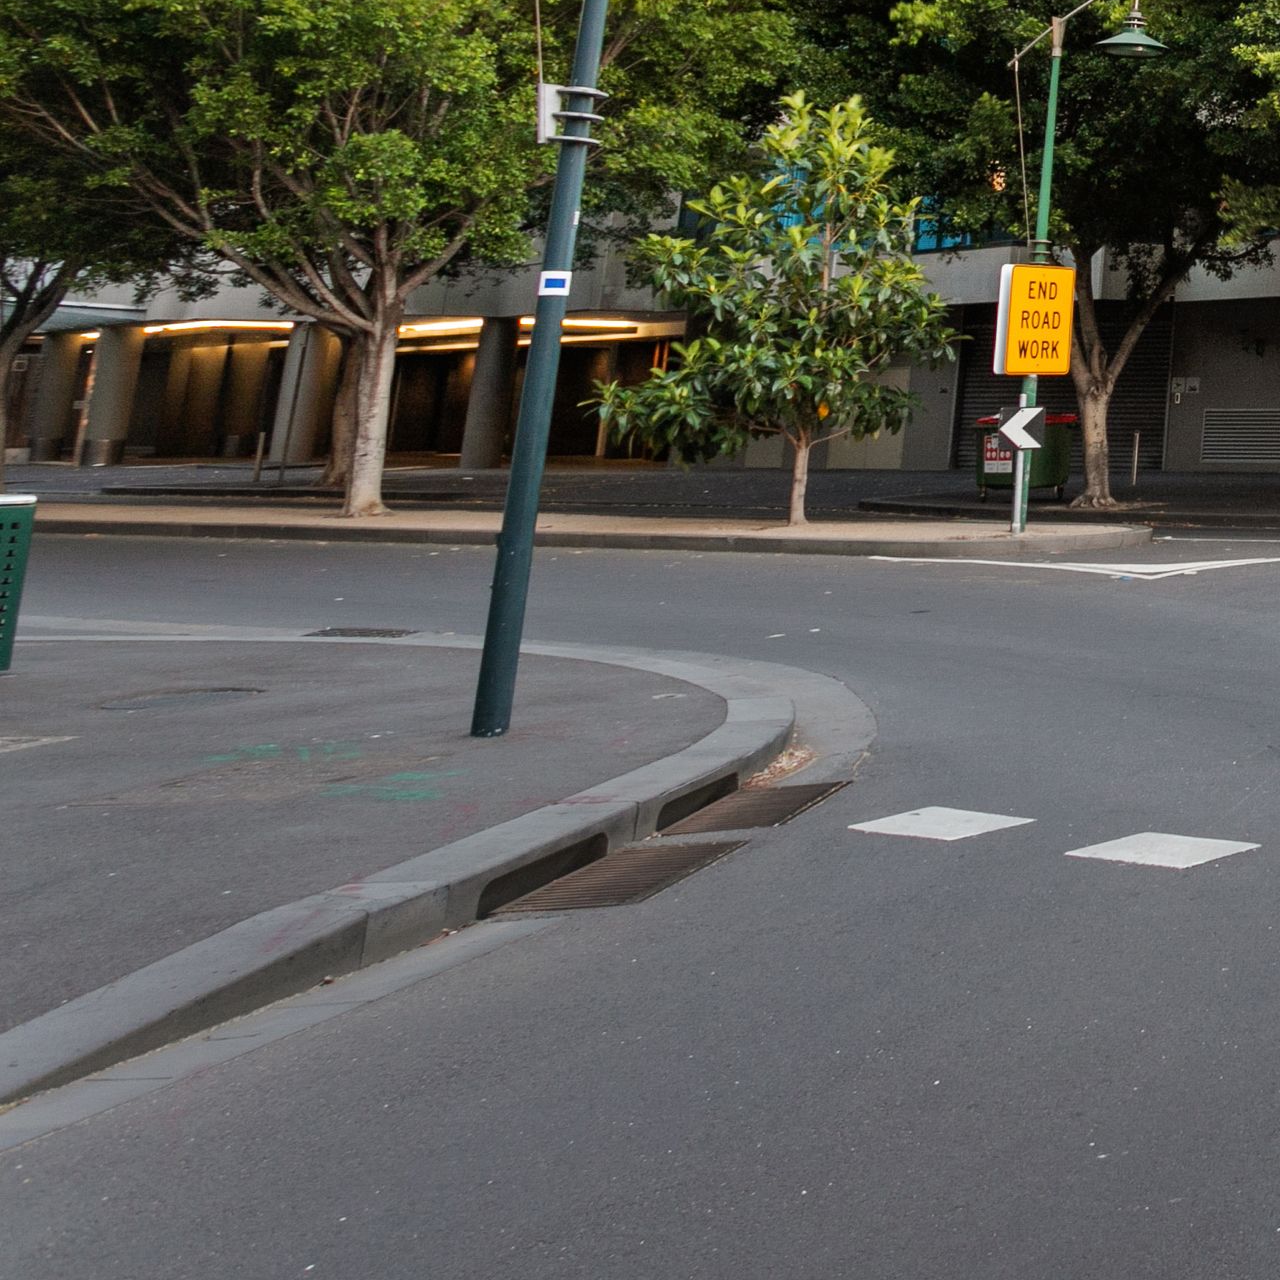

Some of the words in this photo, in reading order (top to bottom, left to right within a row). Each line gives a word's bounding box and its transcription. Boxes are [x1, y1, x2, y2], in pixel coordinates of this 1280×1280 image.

[1028, 281, 1059, 300] END
[1020, 310, 1061, 330] ROAD
[1018, 340, 1060, 359] WORK
